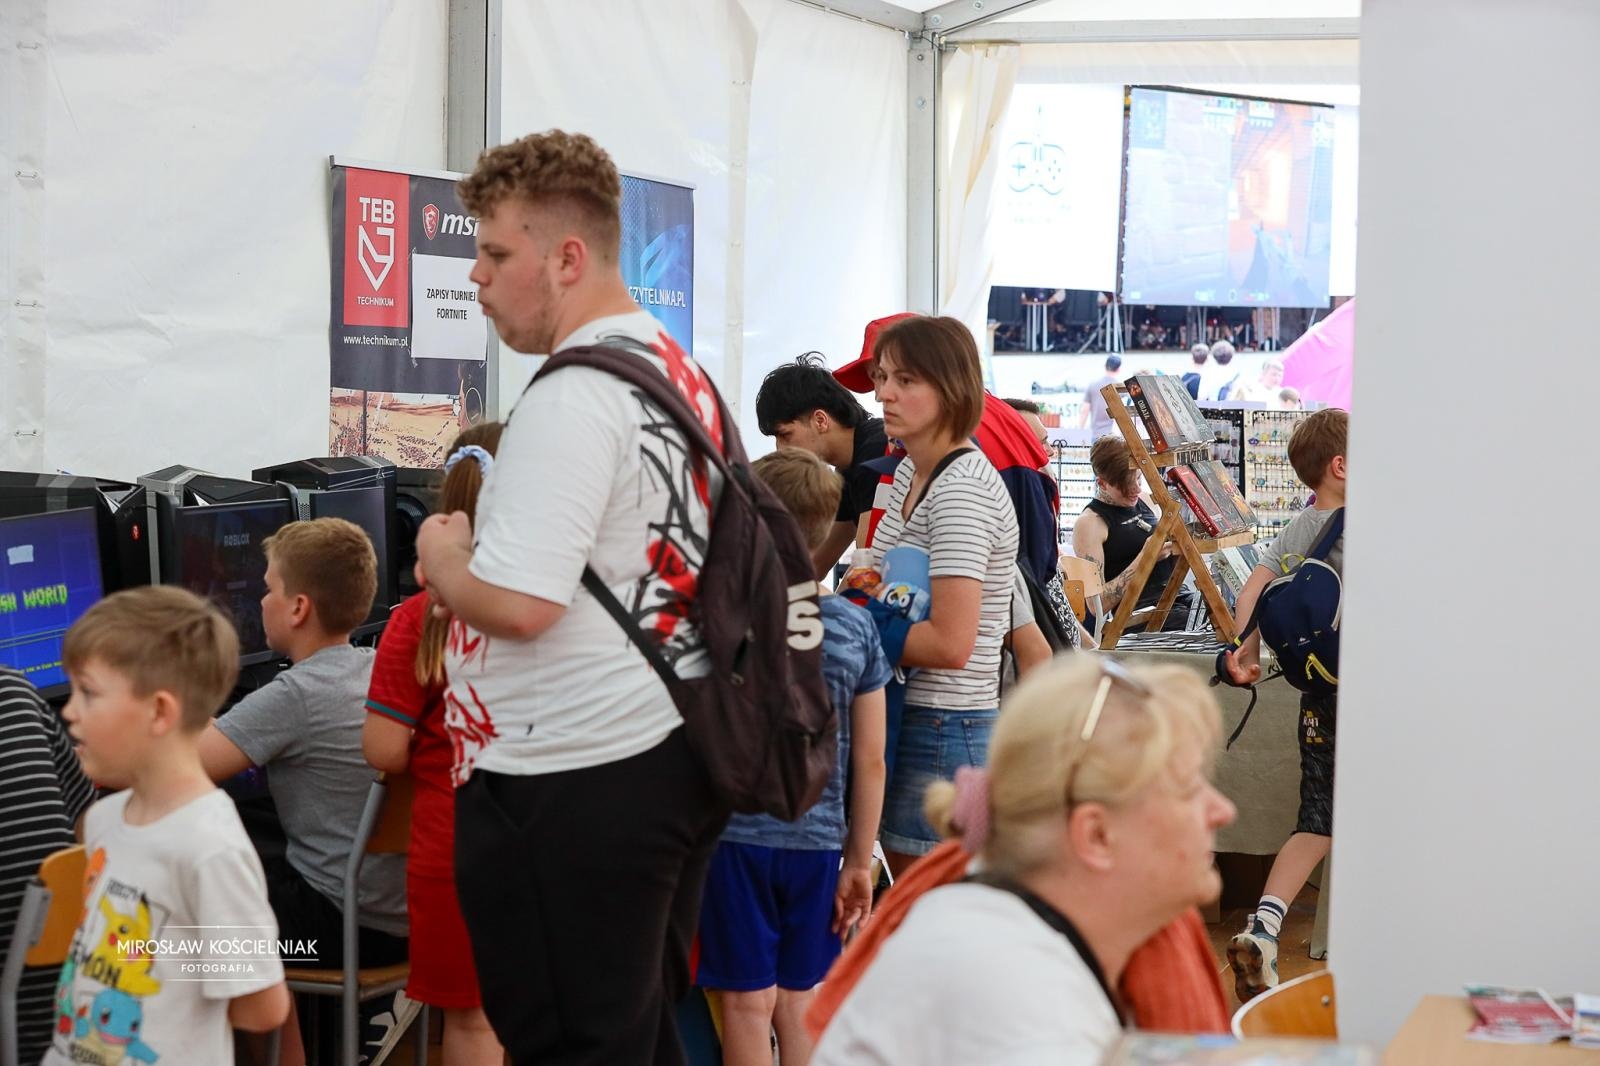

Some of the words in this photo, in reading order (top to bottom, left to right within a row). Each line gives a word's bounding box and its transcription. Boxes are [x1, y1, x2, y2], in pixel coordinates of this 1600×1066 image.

[359, 197, 395, 225] TEB
[441, 213, 480, 237] msi
[426, 288, 450, 300] ZAPISY
[357, 296, 394, 307] TECHNIKUM
[436, 308, 467, 320] FORTNITE
[343, 334, 408, 349] www.technikum.pl
[223, 533, 250, 547] ROBLOX
[22, 583, 68, 609] WORLD
